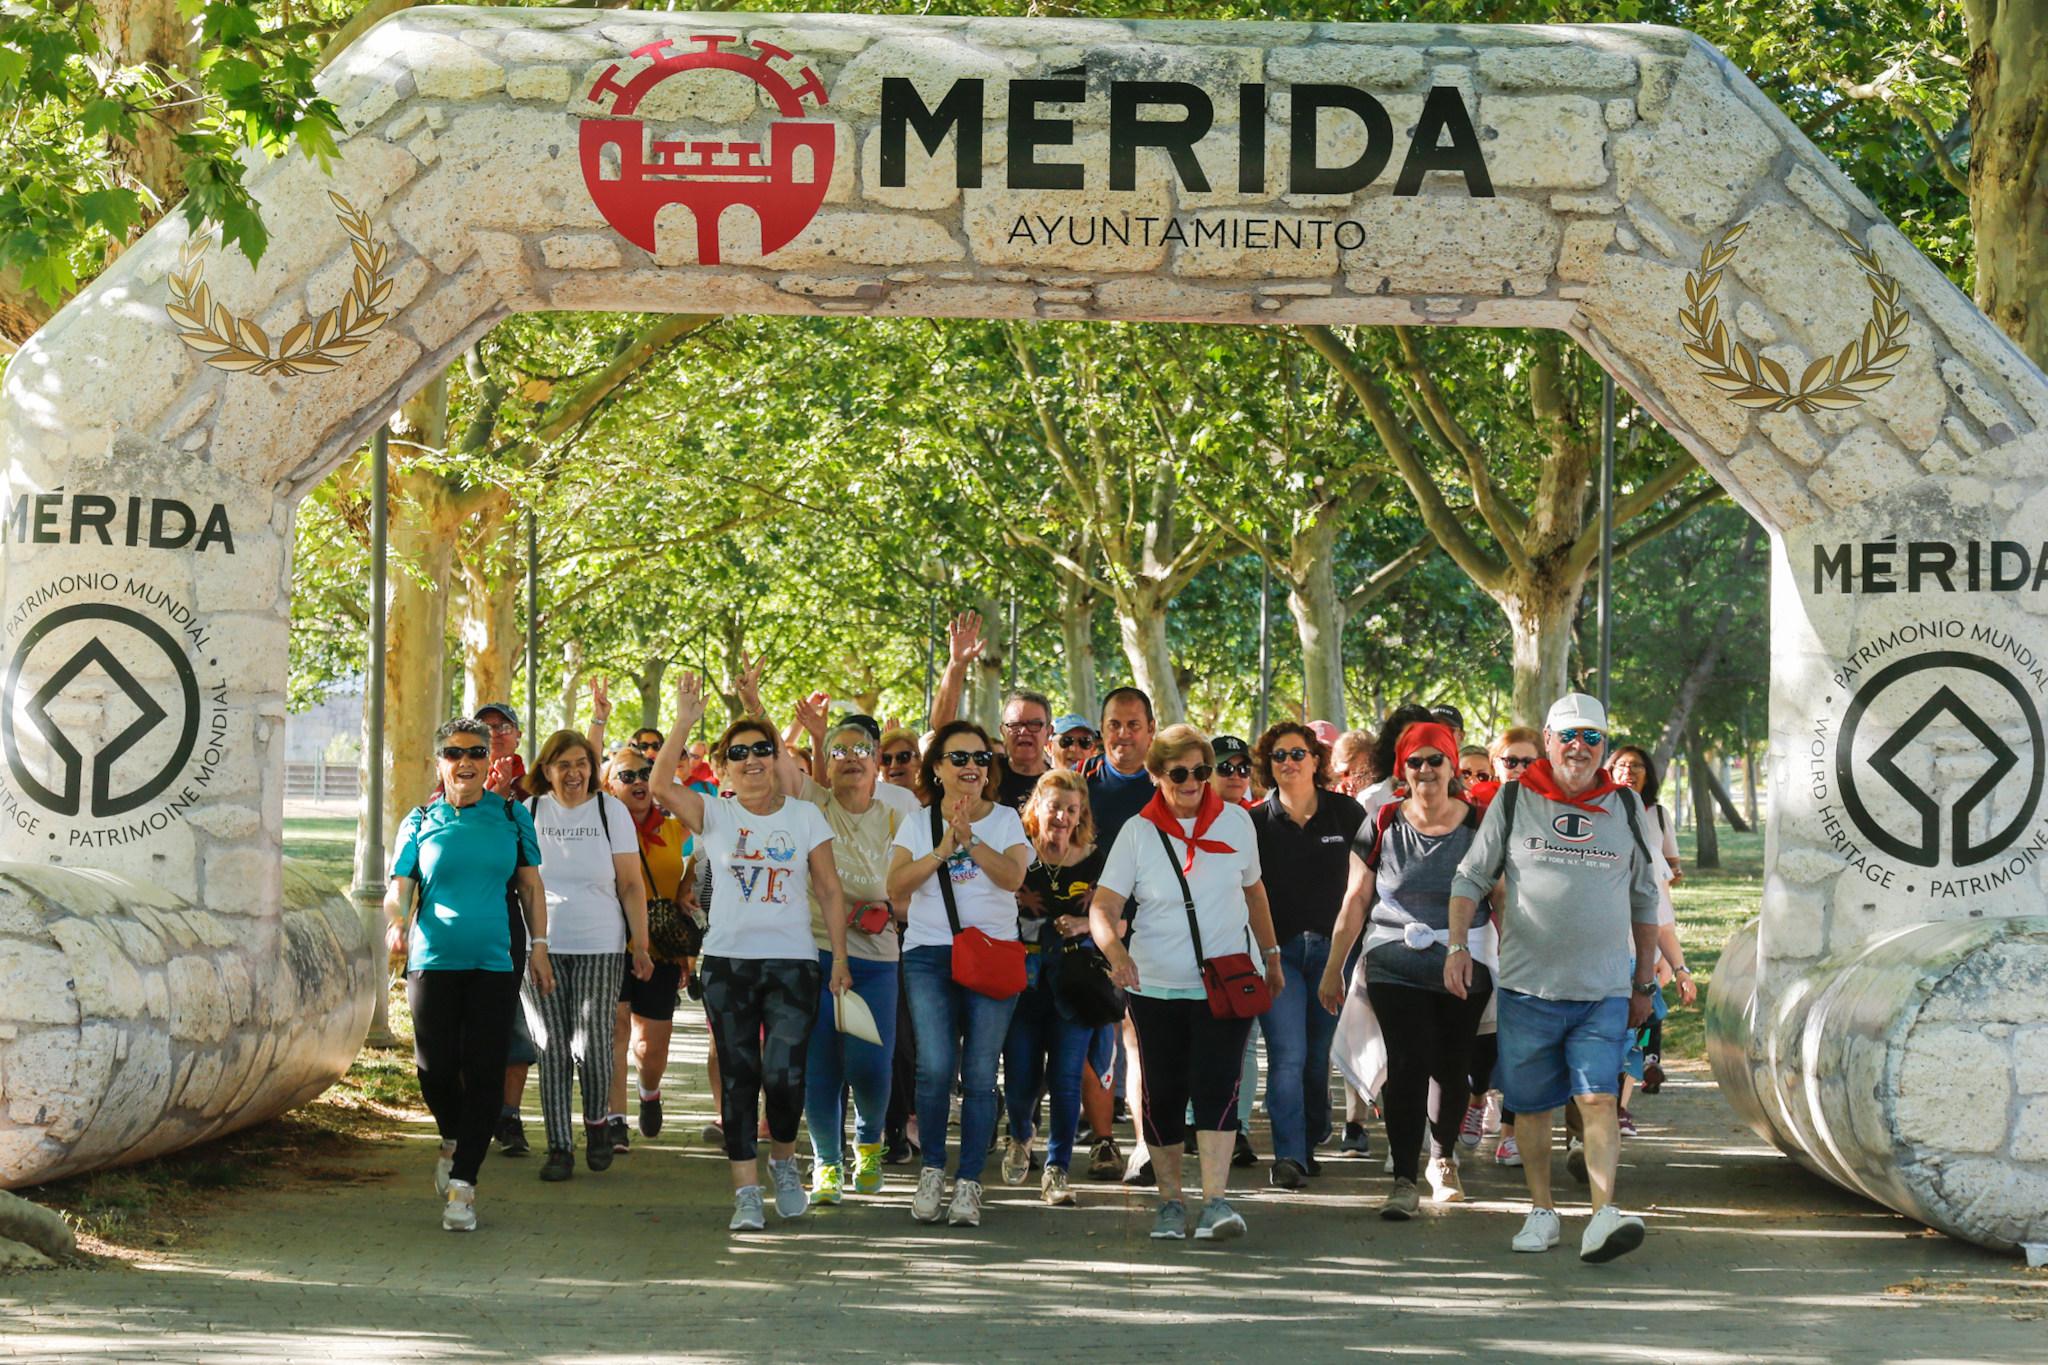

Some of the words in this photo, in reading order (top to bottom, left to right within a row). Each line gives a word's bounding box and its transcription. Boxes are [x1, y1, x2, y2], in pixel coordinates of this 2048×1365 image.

[880, 65, 1496, 197] MÉRIDA
[1007, 215, 1367, 250] AYUNTAMIENTO
[1, 486, 236, 555] MÉRIDA
[6, 573, 118, 637] PATRIMONIO
[124, 577, 211, 653] MUNDIAL
[1833, 620, 1966, 689] PATRIMONIO
[69, 785, 200, 848] PATRIMOINE
[195, 677, 228, 787] MONDIAL
[1810, 717, 1830, 800] WOLRD
[541, 827, 600, 837] BEAUTIFUL
[1523, 837, 1620, 863] Champion
[1548, 856, 1565, 865] YORK
[1818, 805, 1896, 889] HERITAGE
[1930, 828, 2048, 899] PATRIMOINE
